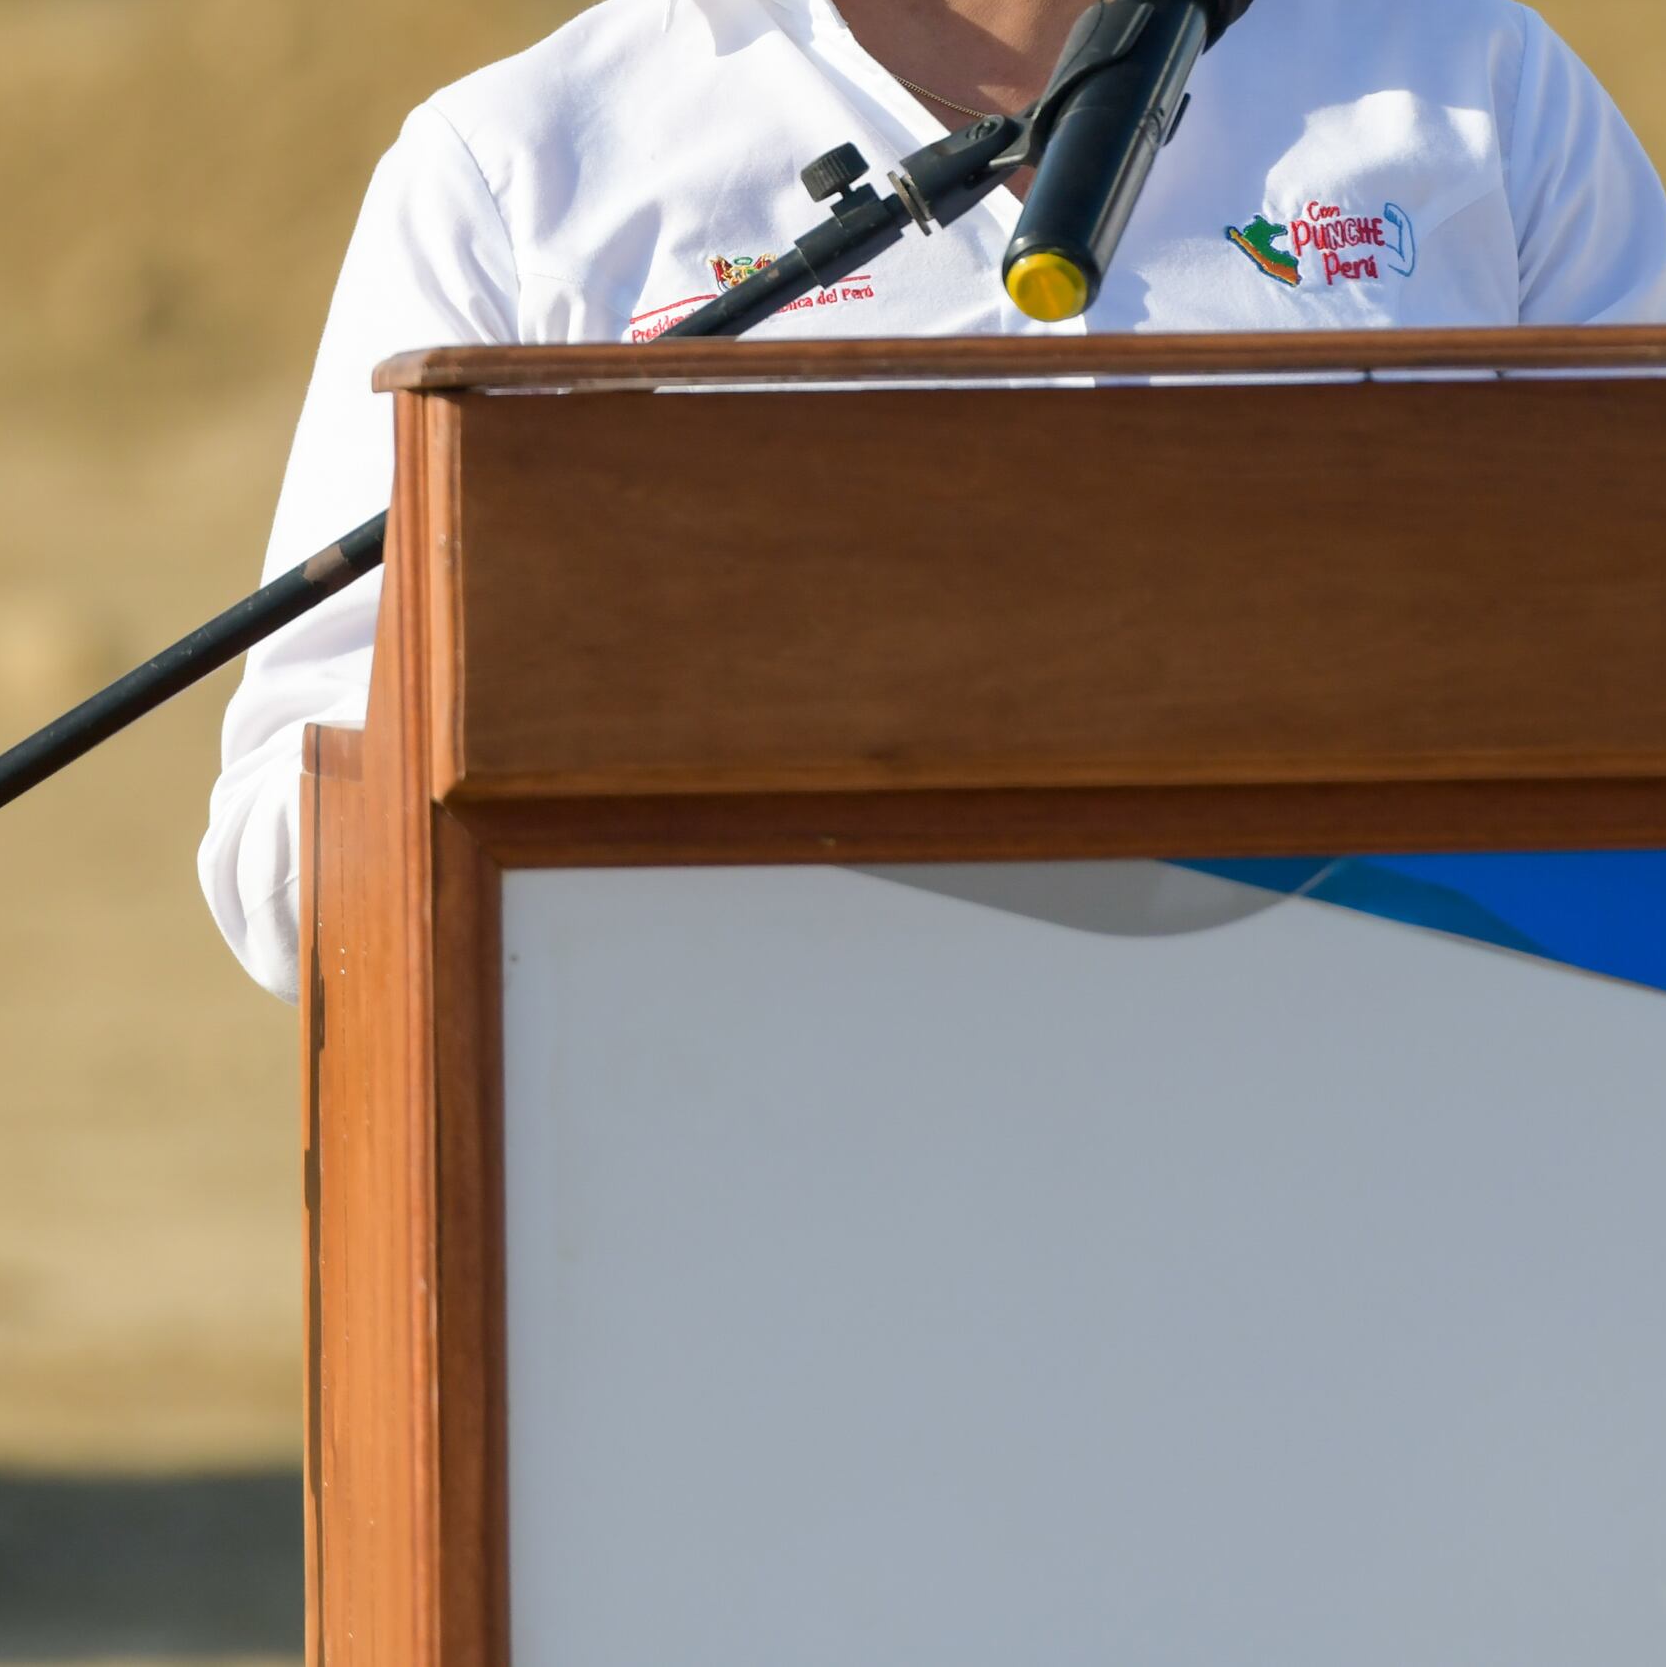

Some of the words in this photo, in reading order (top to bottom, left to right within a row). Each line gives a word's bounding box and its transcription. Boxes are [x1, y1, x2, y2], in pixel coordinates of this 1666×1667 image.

[1307, 200, 1341, 222] Con
[1290, 216, 1386, 257] PUNCHE
[1322, 251, 1379, 286] Perú
[816, 287, 838, 306] del
[841, 284, 875, 301] Perú
